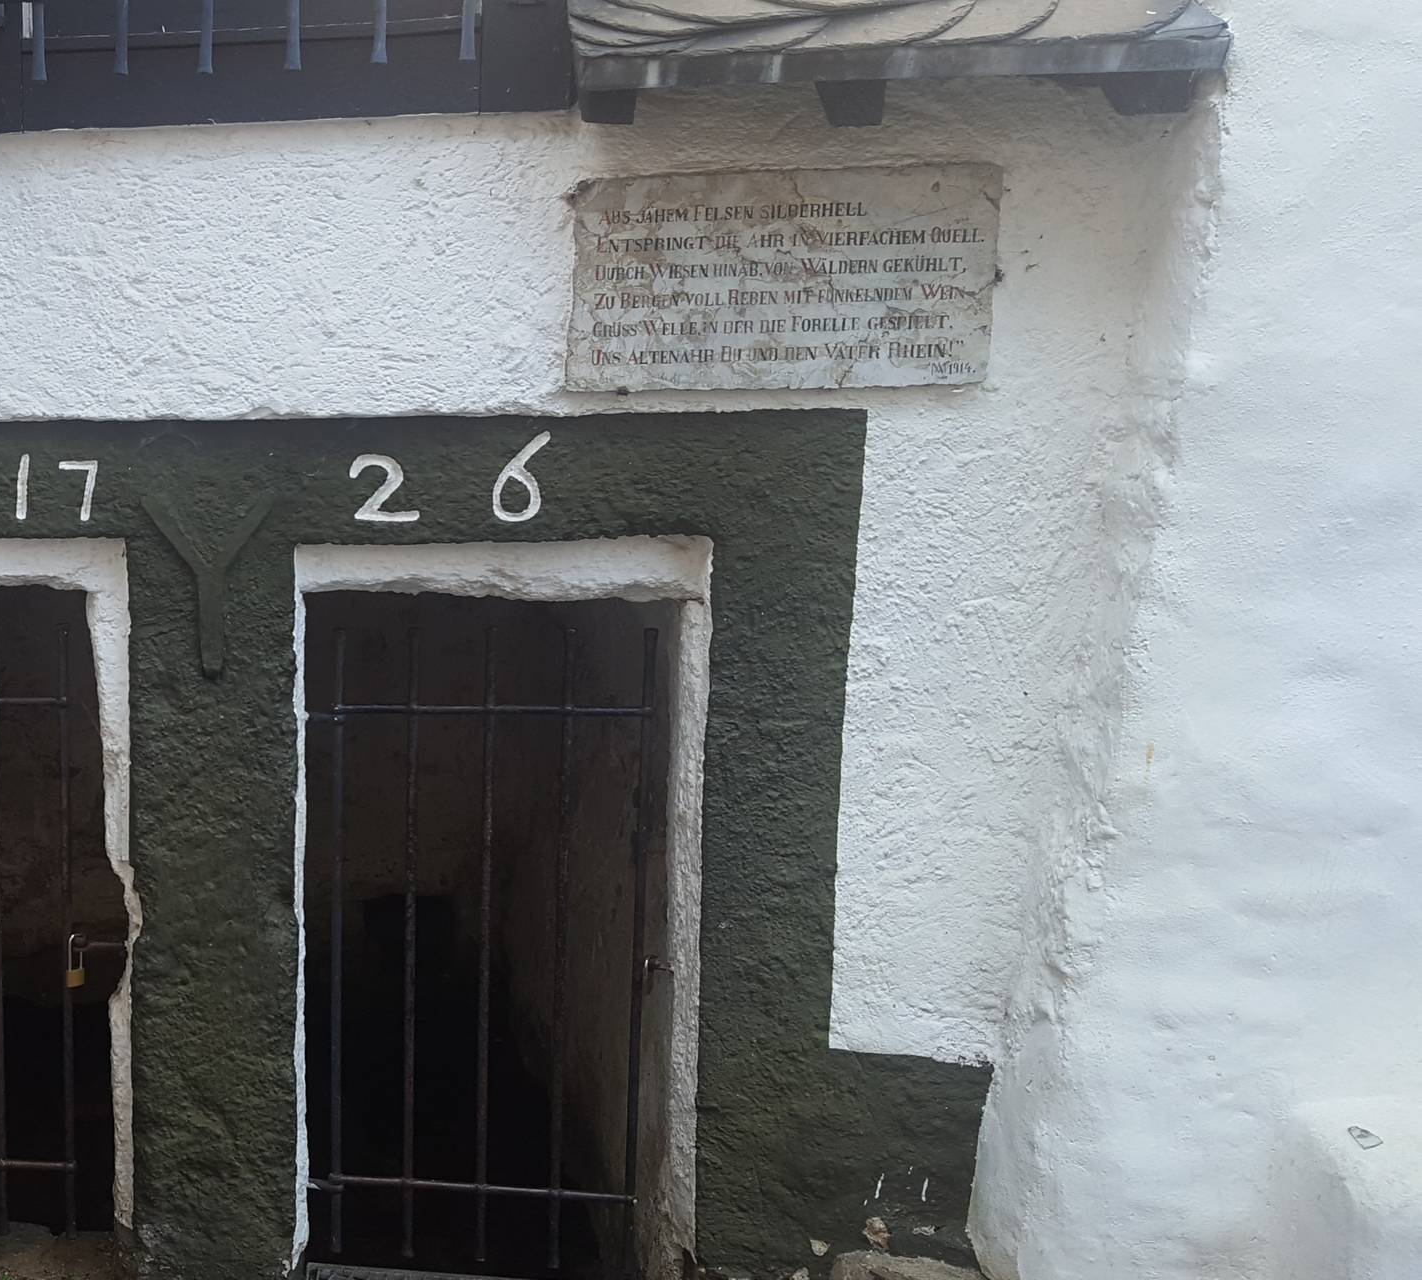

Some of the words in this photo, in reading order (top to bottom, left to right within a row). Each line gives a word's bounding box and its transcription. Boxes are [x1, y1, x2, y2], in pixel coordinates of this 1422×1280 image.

[598, 209, 631, 225] AUS
[693, 204, 754, 223] FELSEN
[759, 202, 867, 220] SILBERHELL
[596, 235, 709, 253] ENTSPRINGT
[715, 235, 739, 250] DIE
[746, 233, 784, 249] AHR
[818, 230, 926, 247] VIERFACHEM
[930, 226, 985, 244] QUELL.
[595, 264, 645, 281] DURCH
[649, 263, 709, 280] WIESEN
[800, 257, 878, 275] WÄLDERN
[882, 254, 968, 274] GEKÜHLT,
[593, 293, 615, 310] ZU
[619, 291, 680, 309] BERGEN
[684, 292, 724, 307] VOLL
[728, 288, 778, 306] REBEN
[783, 289, 814, 305] MIT
[817, 286, 913, 304] FUNKELNDEM
[723, 320, 755, 334] DER
[759, 319, 787, 335] DIE
[791, 315, 860, 333] FORELLE
[591, 348, 621, 366] UNS
[628, 348, 715, 366] ALTENAHR
[747, 347, 779, 362] UND
[784, 345, 818, 361] DEN
[15, 453, 99, 521] 17
